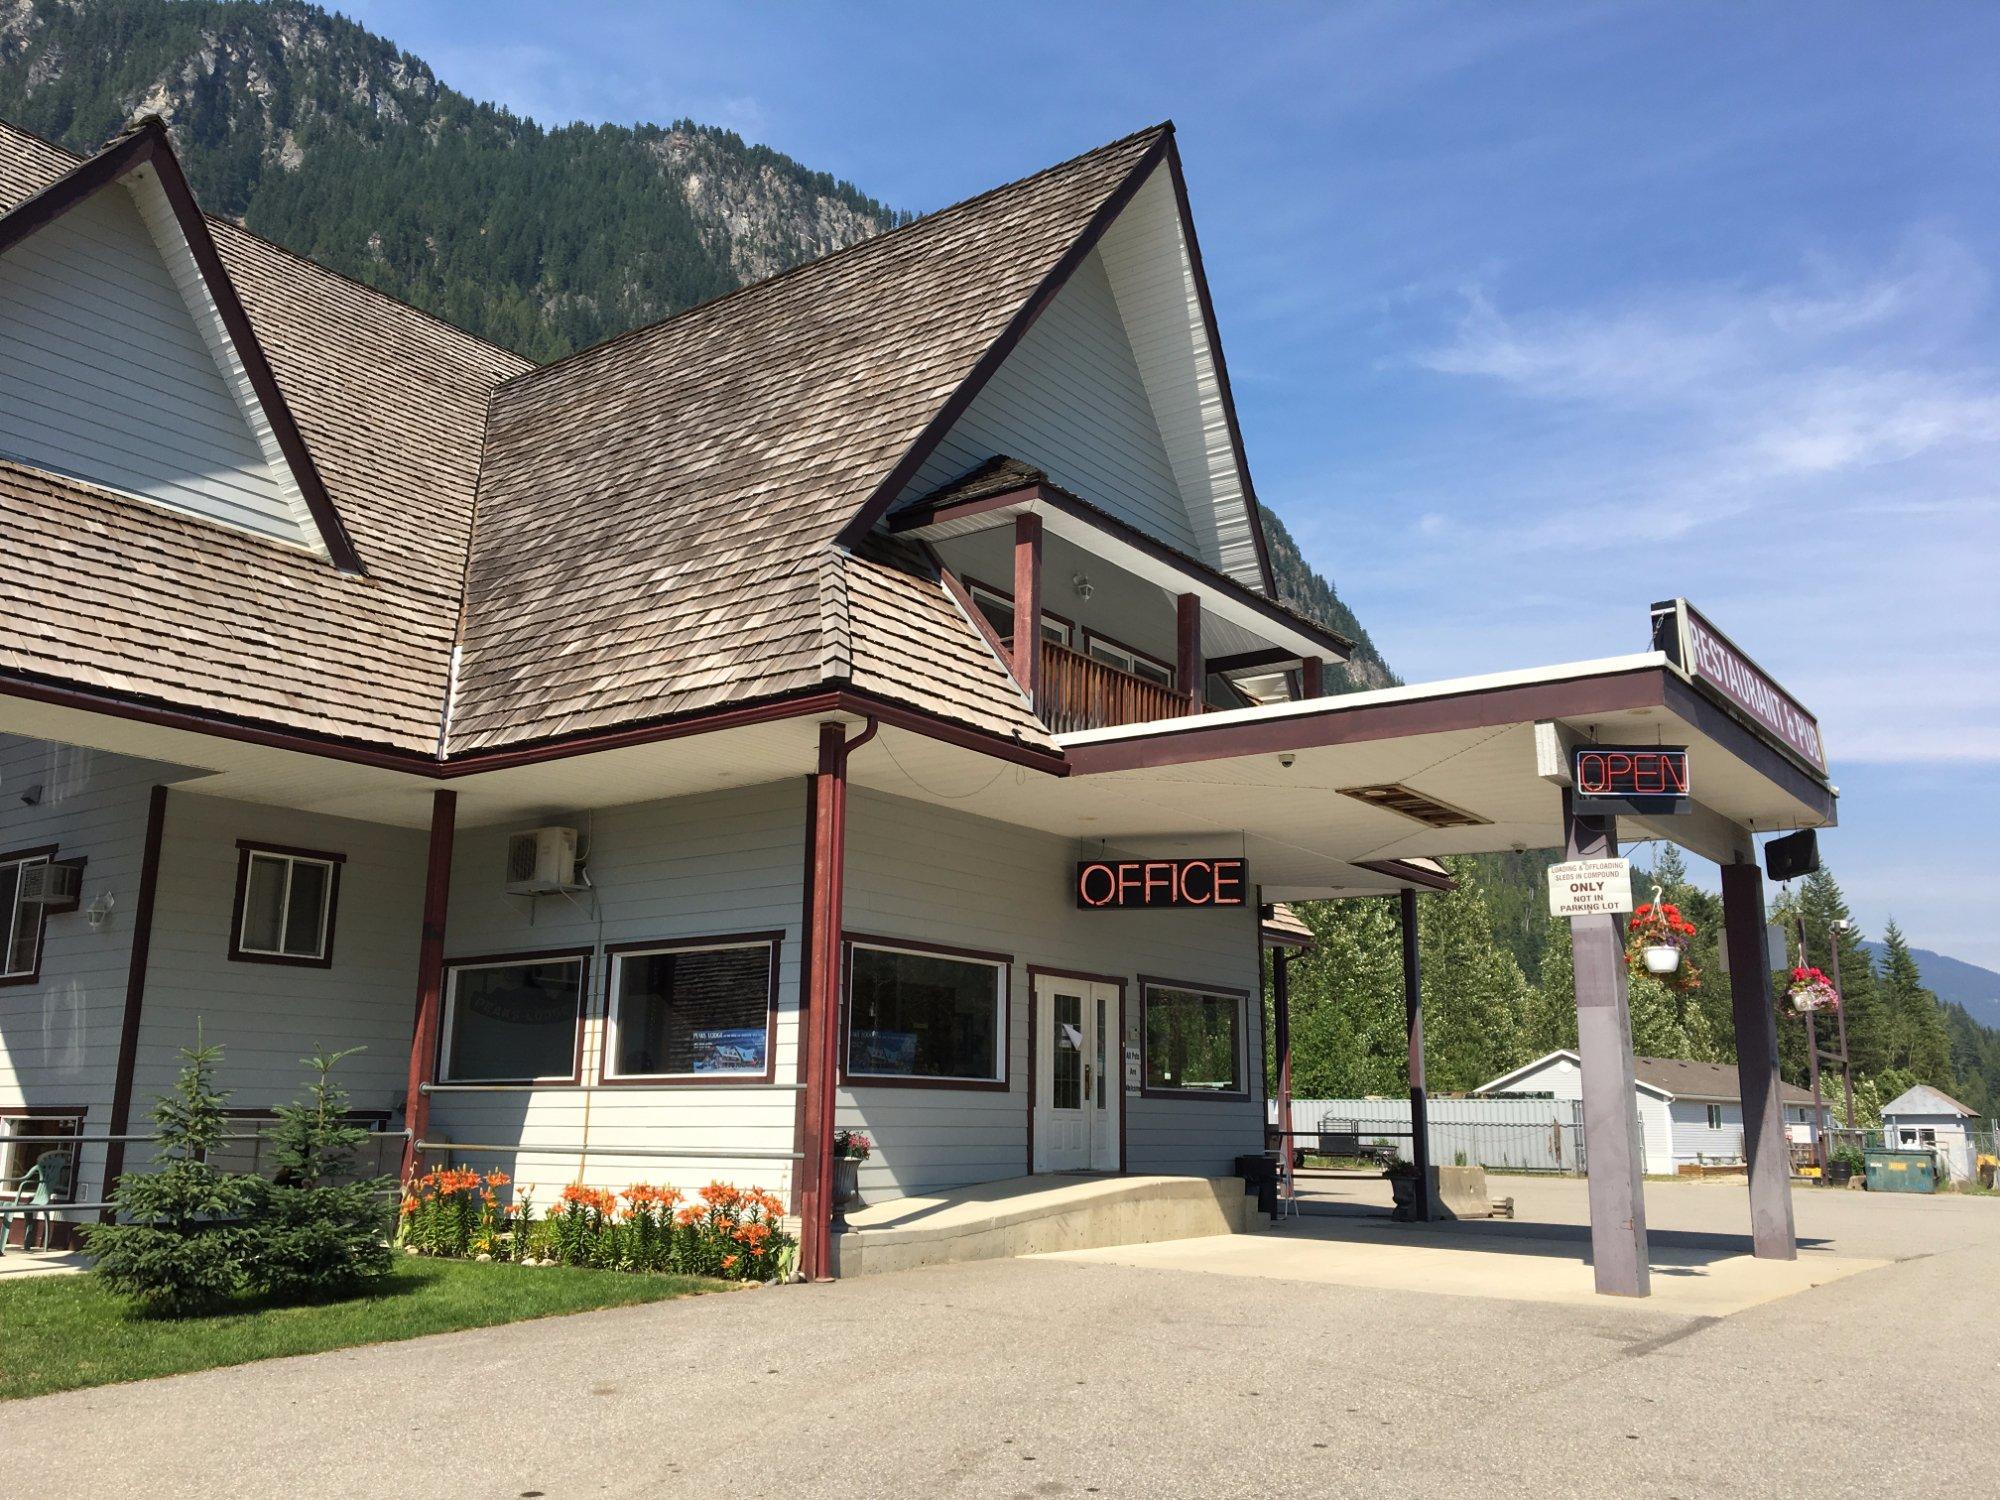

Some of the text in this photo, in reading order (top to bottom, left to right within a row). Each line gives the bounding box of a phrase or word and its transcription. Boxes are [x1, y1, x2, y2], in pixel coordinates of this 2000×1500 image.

[1688, 618, 1823, 764] RESTAURANT & PUB
[1580, 754, 1687, 792] OPEN
[1552, 865, 1577, 874] LOADING
[1584, 862, 1624, 871] OFFLOADING
[1583, 871, 1620, 879] COMPOUND
[1080, 861, 1241, 906] OFFICE
[1570, 881, 1604, 892] ONLY
[1560, 902, 1619, 912] PARKING LOT
